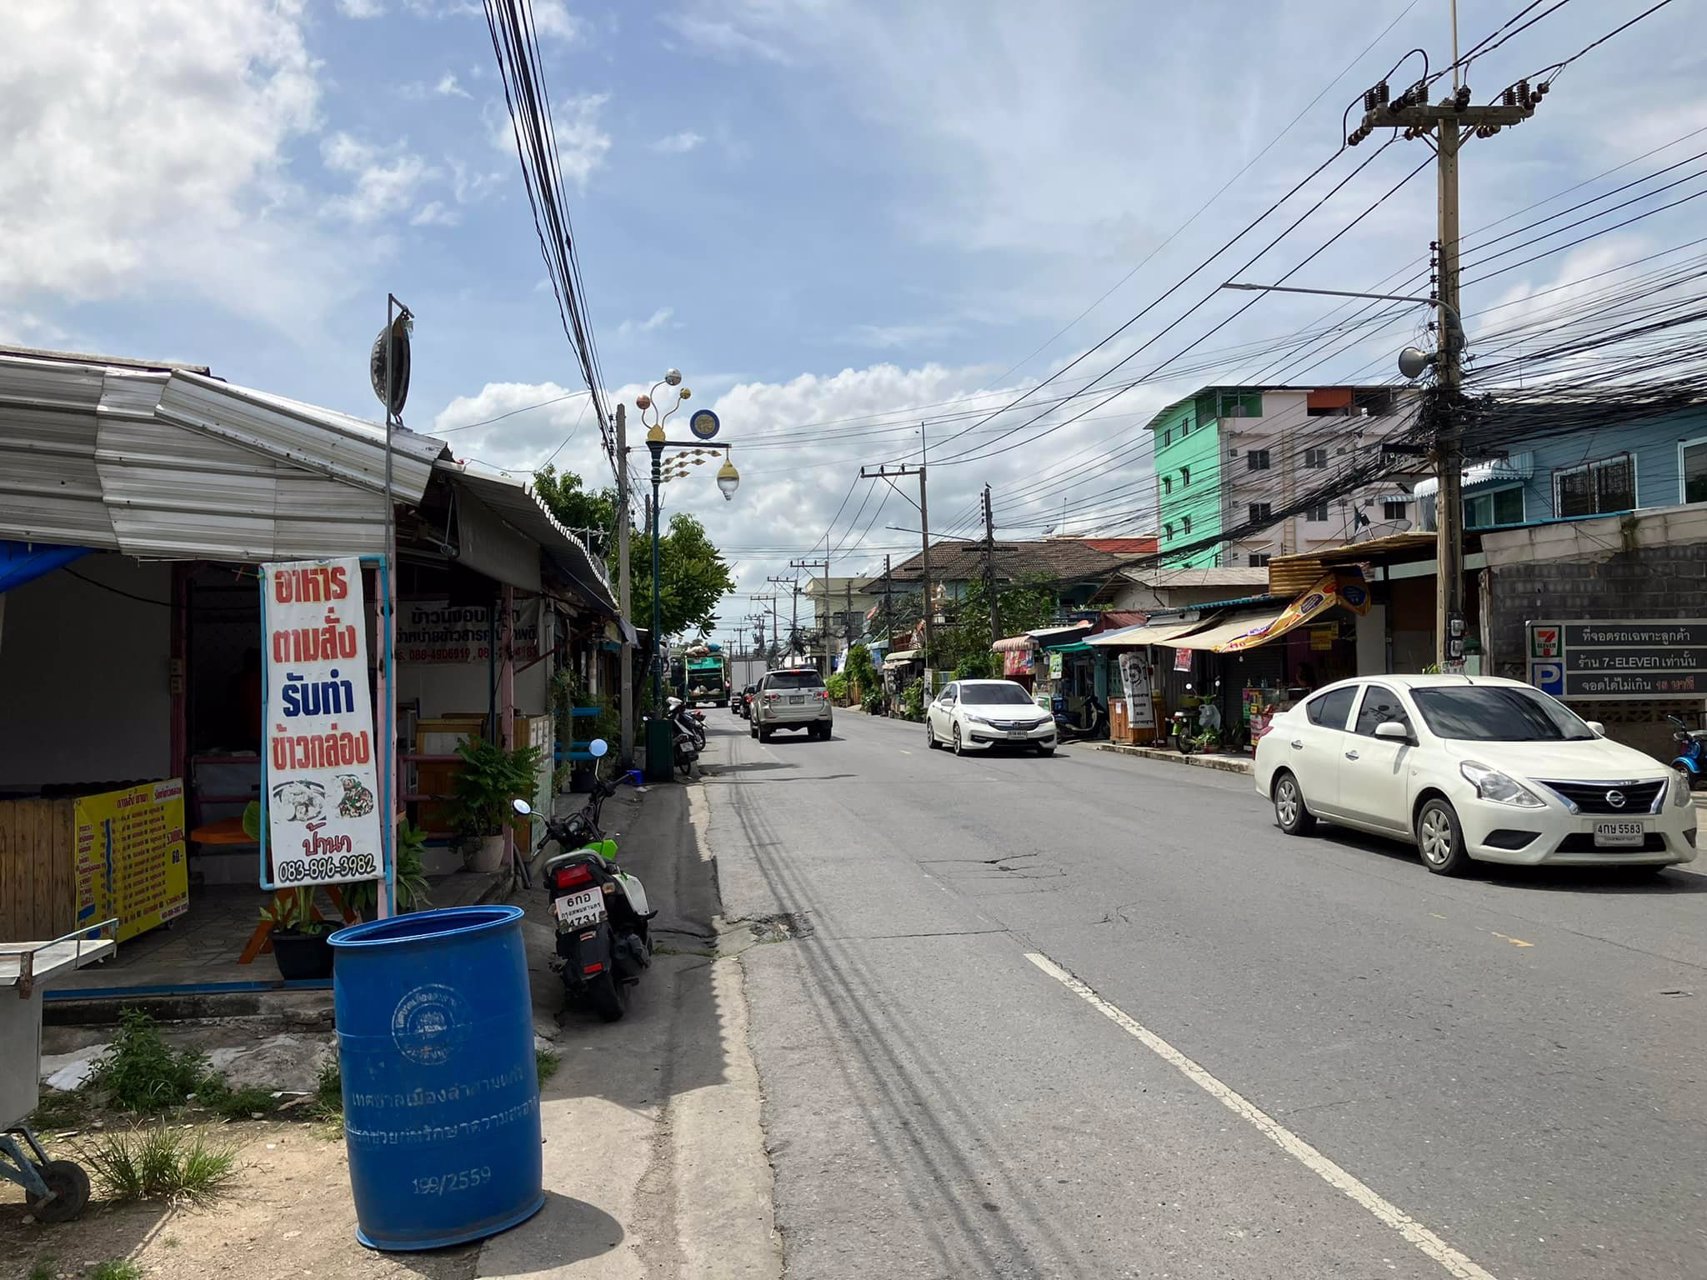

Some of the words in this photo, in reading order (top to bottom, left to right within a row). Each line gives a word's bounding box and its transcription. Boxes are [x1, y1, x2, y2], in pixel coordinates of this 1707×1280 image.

[275, 566, 348, 604] อาหาร
[273, 607, 357, 664] ตามสั่ง
[1582, 627, 1691, 645] ที่จอดรถเฉพาะลูกค้า
[1578, 655, 1600, 668] ร้าน
[1662, 651, 1697, 667] เท่านั้น
[1534, 664, 1561, 690] P
[1582, 677, 1652, 691] จอดได้ไม่เกิน
[281, 669, 355, 717] รับทำ
[272, 724, 371, 770] ข้าวกล่อง
[302, 821, 352, 856] ป้านา
[1618, 824, 1641, 834] 5583
[278, 852, 377, 883] 083-896-3982
